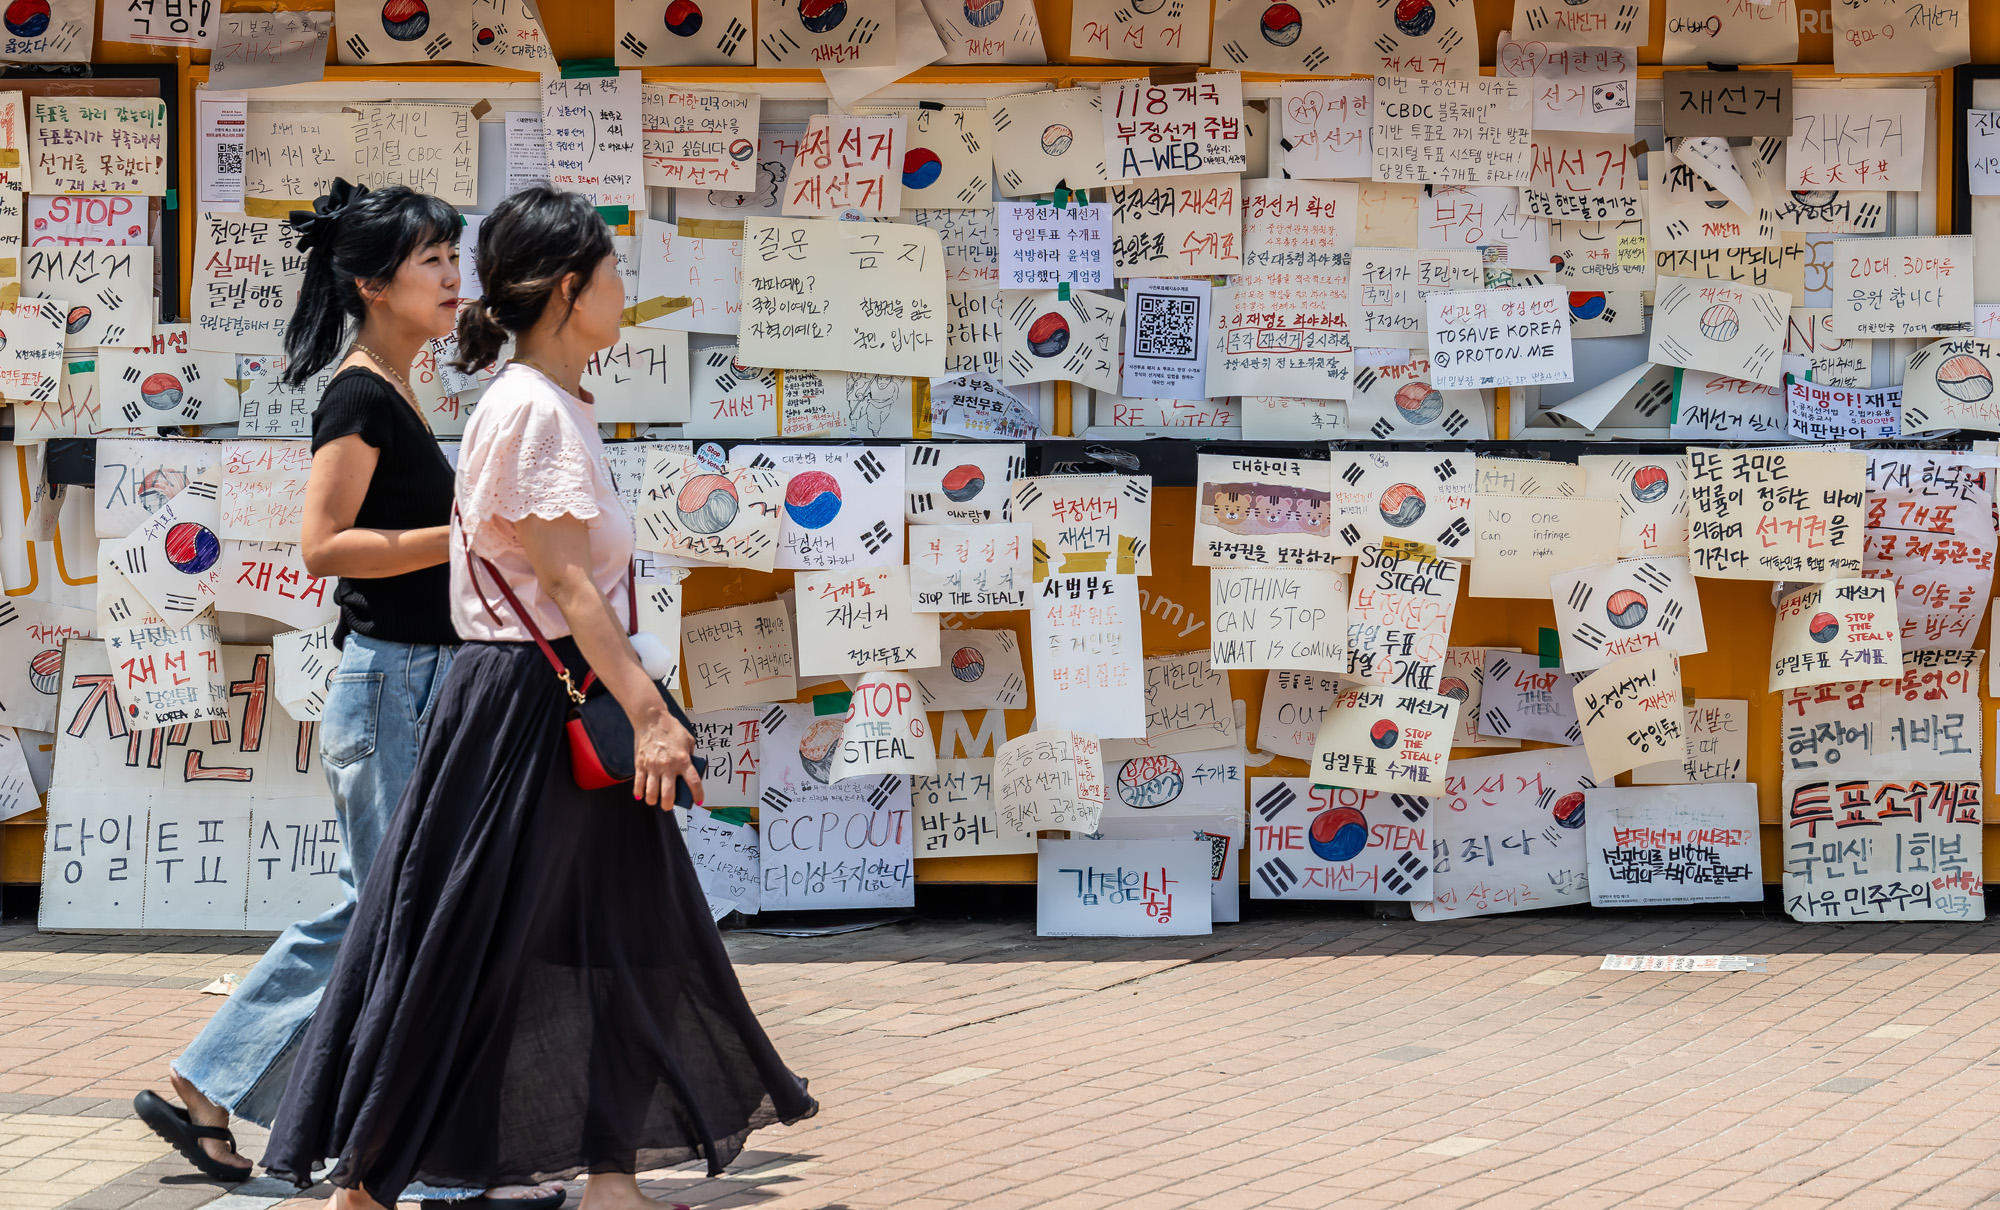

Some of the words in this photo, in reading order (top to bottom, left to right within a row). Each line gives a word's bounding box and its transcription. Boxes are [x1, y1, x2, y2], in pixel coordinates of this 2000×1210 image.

[1554, 10, 1607, 31] 재선거
[517, 29, 539, 40] 자유
[1083, 22, 1183, 50] 재선거
[5, 38, 48, 54] 옳았다
[223, 39, 316, 64] 재선거
[811, 45, 861, 63] 재선거
[965, 40, 1005, 57] 재선거
[1381, 56, 1447, 74] 재선거
[1548, 51, 1626, 74] 대한민국
[1378, 76, 1407, 94] 이번
[1479, 81, 1518, 96] 이슈는
[1680, 86, 1782, 114] 재선거
[35, 104, 69, 123] 투표를
[79, 107, 106, 121] 하러
[674, 116, 694, 133] 않은
[701, 118, 739, 134] 역사를
[1117, 122, 1196, 145] 부정선거
[1204, 116, 1239, 140] 주범
[1378, 124, 1403, 140] 기반
[1411, 124, 1446, 141] 투표로
[1453, 128, 1472, 140] 가기
[37, 128, 103, 146] 투표용지가
[111, 129, 160, 149] 부족해서
[682, 141, 726, 156] 싶습니다
[1794, 113, 1903, 166] 재선거
[39, 153, 87, 175] 선거를
[100, 155, 164, 176] 못했다!
[1122, 142, 1203, 177] A-WEB
[1378, 146, 1418, 161] 디지털
[1424, 146, 1445, 162] 투표
[1450, 149, 1481, 163] 시스템
[1530, 143, 1627, 192] 재선거
[793, 174, 885, 212] 재선거
[1242, 189, 1299, 217] 부정선거
[1525, 190, 1551, 214] 잠실
[49, 196, 132, 226] STOP
[1012, 208, 1060, 221] 부정선거
[1066, 208, 1099, 221] 재선거
[1112, 186, 1175, 223] 부정선거
[1179, 187, 1233, 216] 재선거
[1306, 196, 1336, 218] 확인
[1430, 201, 1484, 243] 부정
[1012, 229, 1060, 241] 당일투표
[1067, 229, 1101, 241] 수개표
[1012, 249, 1060, 262] 석방하라
[1067, 249, 1101, 262] 윤석열
[1113, 232, 1169, 268] 당일투표
[1180, 230, 1239, 266] 수개표
[1586, 248, 1611, 259] 자유
[27, 250, 132, 283] 재선거
[205, 249, 275, 278] 실패는
[1362, 262, 1411, 282] 우리가
[1904, 256, 1955, 277] 30대를
[1012, 270, 1061, 283] 정당했다
[1067, 270, 1101, 283] 계엄령
[1700, 287, 1744, 304] 재선거
[1847, 289, 1882, 311] 응원
[8, 302, 40, 319] 재선거
[1365, 312, 1419, 331] 부정선거
[1507, 319, 1561, 338] KOREA
[1259, 332, 1301, 349] 재선거
[710, 394, 774, 419] 재선거
[953, 395, 1003, 413] 원천무효
[1683, 405, 1744, 432] 재선거
[1793, 419, 1866, 440] 재판받아
[1233, 461, 1300, 476] 대한민국
[1691, 452, 1723, 480] 모든
[1732, 454, 1789, 482] 국민은
[1051, 497, 1118, 523] 부정선거
[1692, 484, 1743, 518] 법률이
[1757, 486, 1811, 512] 정하는
[1824, 490, 1863, 509] 바에
[1532, 512, 1560, 523] one
[1059, 526, 1111, 551] 재선거
[1533, 530, 1571, 541] infringe
[1693, 522, 1742, 541] 의하여
[1756, 515, 1848, 549] 선거권을
[1209, 541, 1269, 563] 참정권을
[1360, 545, 1412, 571] STOP
[1416, 554, 1458, 582] THE
[237, 562, 326, 607] 재선거
[1043, 577, 1114, 599] 사법부도
[1216, 578, 1301, 605] NOTHING
[1376, 571, 1442, 596] STEAL
[1836, 585, 1884, 602] 재선거
[919, 591, 943, 605] STOP
[949, 592, 972, 605] THE
[978, 591, 1024, 606] STEAL!
[826, 602, 888, 629] 재선거
[1216, 609, 1255, 633] CAN
[1270, 607, 1325, 630] STOP
[1845, 612, 1875, 623] STOP
[1848, 622, 1872, 632] THE
[1267, 642, 1283, 660] IS
[1291, 642, 1342, 660] COMING
[1605, 632, 1660, 657] 재선거
[120, 650, 219, 690] 재선거
[1775, 652, 1831, 676] 당일투표
[1839, 649, 1887, 667] 수개표
[1335, 690, 1384, 708] 부정선거
[1395, 696, 1449, 719] 재선거
[856, 722, 892, 738] THE
[1404, 728, 1432, 740] STOP
[844, 738, 915, 764] STEAL
[1404, 739, 1423, 749] THE
[1192, 763, 1242, 785] 수개표
[1322, 752, 1377, 776] 당일투표
[1385, 760, 1432, 784] 수개표
[768, 812, 839, 852] CCP
[845, 809, 910, 848] OUT
[1254, 826, 1304, 851] THE
[1367, 825, 1428, 851] STEAL
[1613, 826, 1681, 849] 부정선거
[1302, 864, 1378, 894] 재선거
